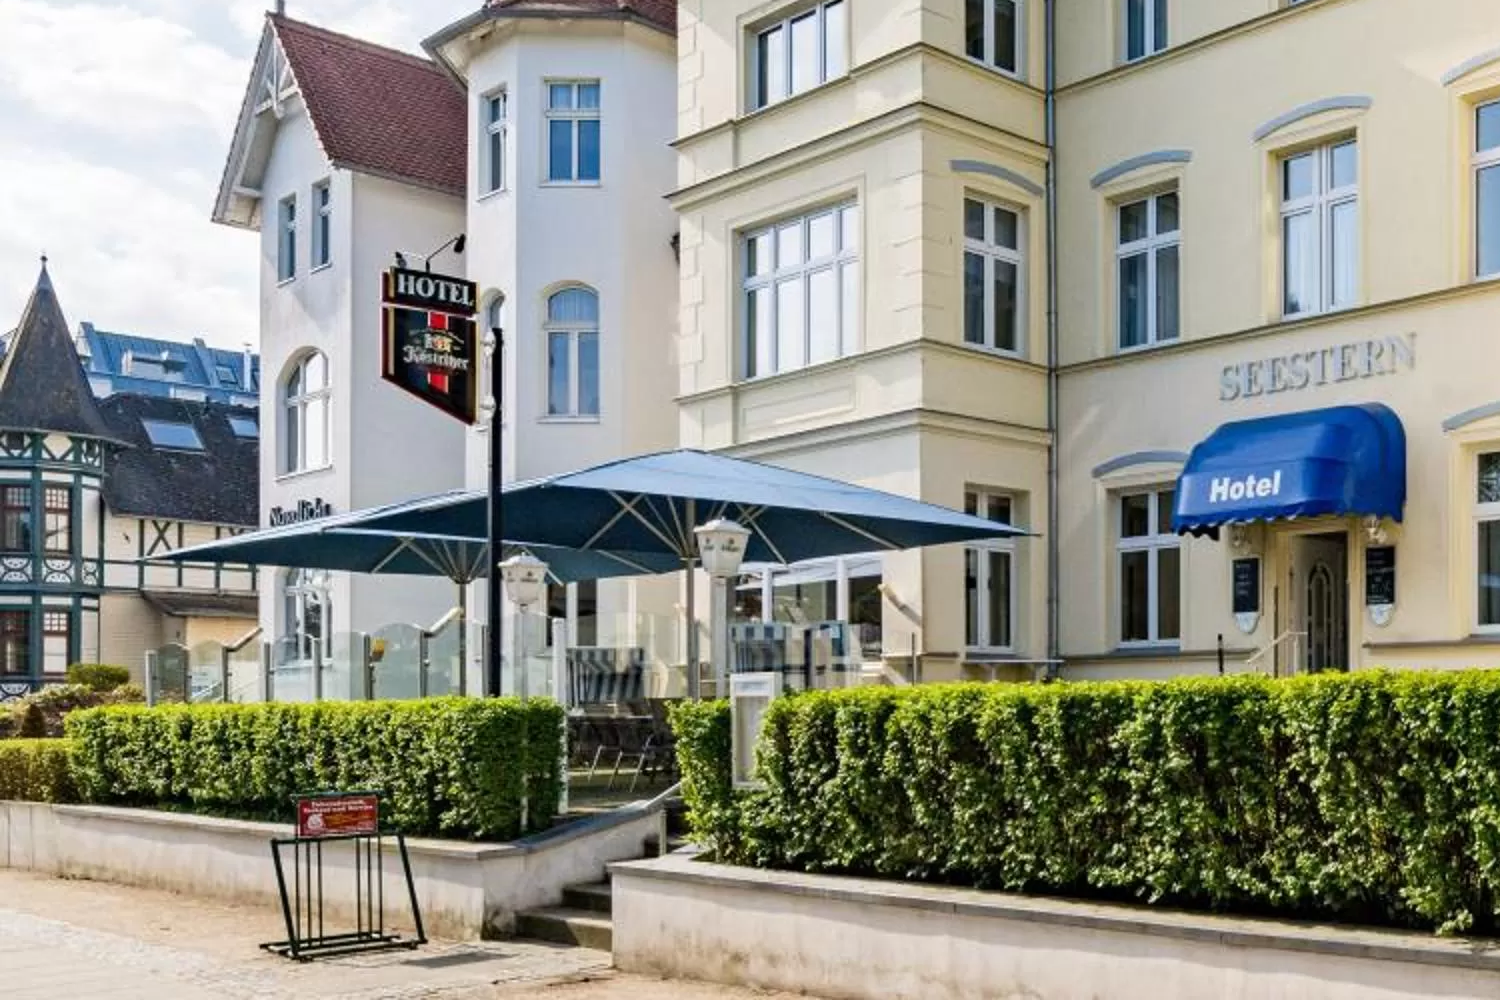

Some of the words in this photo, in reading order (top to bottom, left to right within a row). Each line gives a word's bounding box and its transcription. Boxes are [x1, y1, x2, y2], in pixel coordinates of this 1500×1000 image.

[397, 273, 473, 305] HOTEL
[1219, 332, 1417, 400] SEESTERN
[1209, 469, 1282, 503] Hotel
